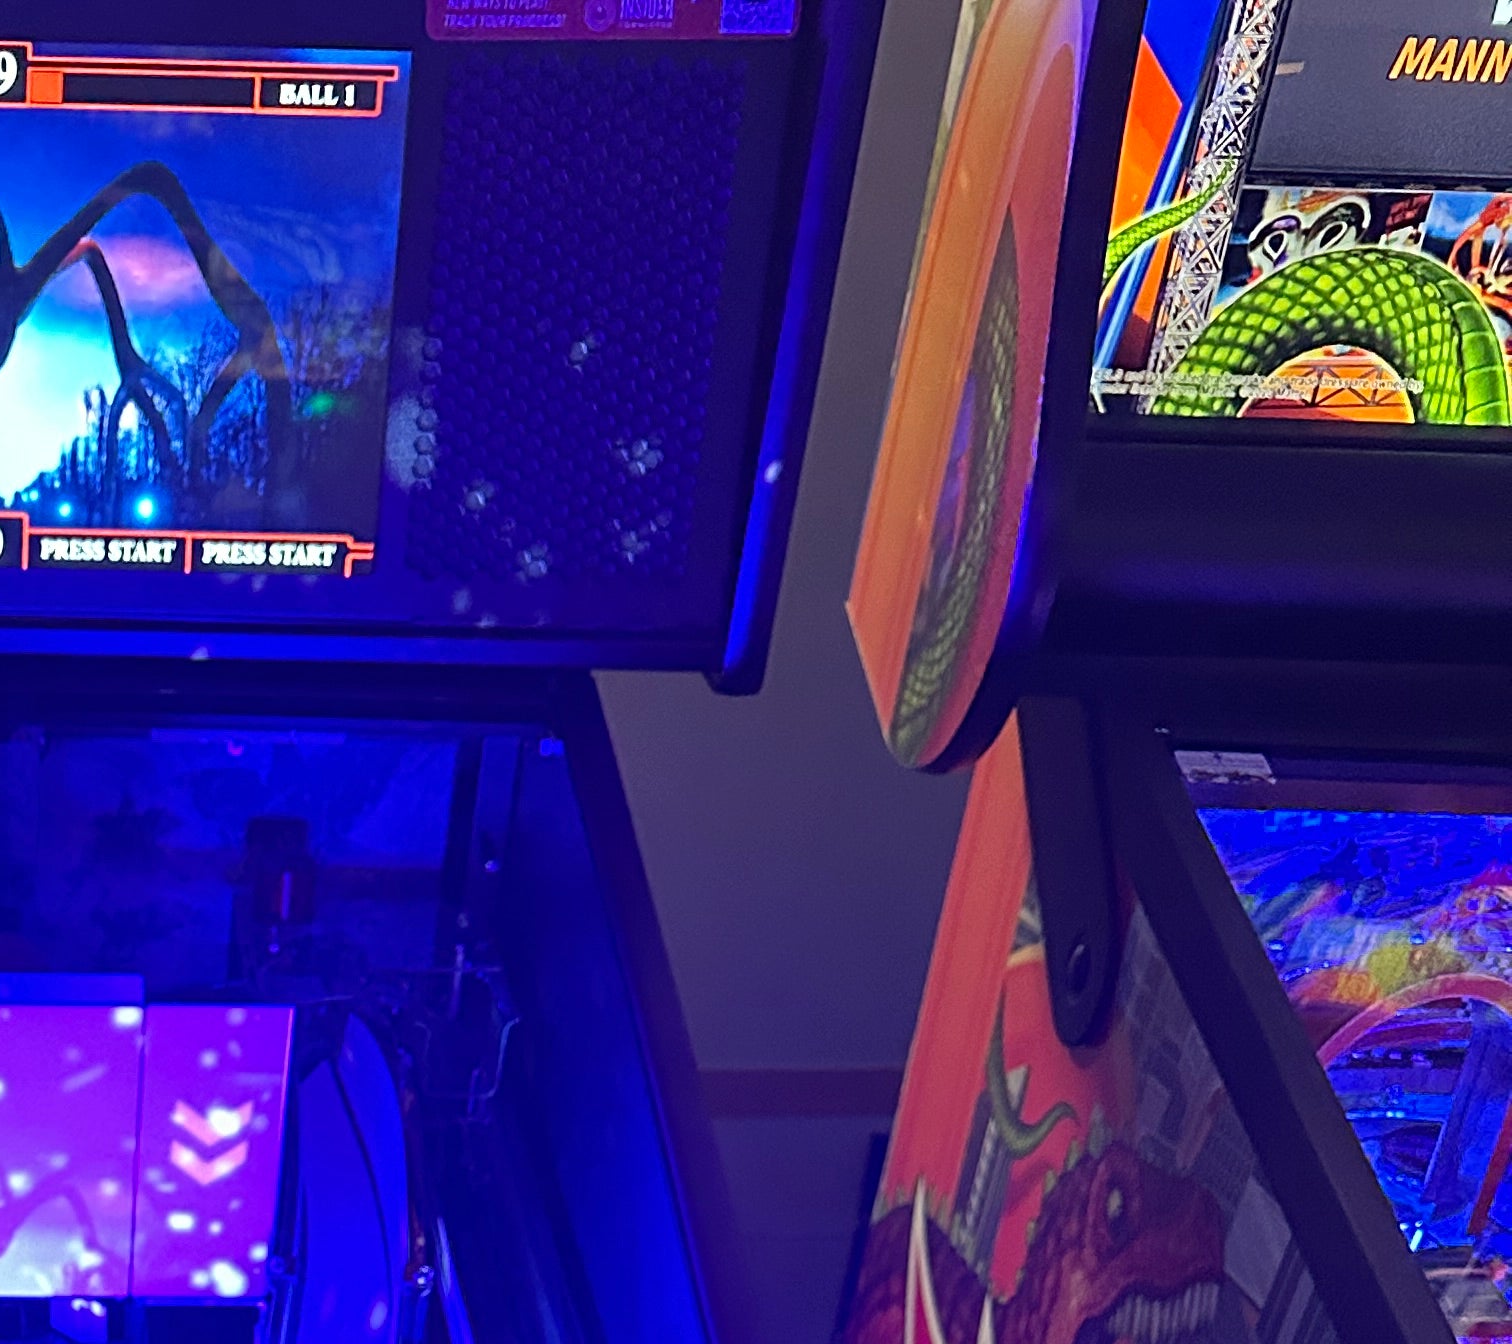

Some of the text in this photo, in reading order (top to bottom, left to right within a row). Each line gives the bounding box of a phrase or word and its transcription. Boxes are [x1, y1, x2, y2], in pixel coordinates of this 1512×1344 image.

[279, 83, 356, 107] BALL 1
[40, 538, 177, 565] PRESS START
[202, 541, 336, 567] PRESS START
